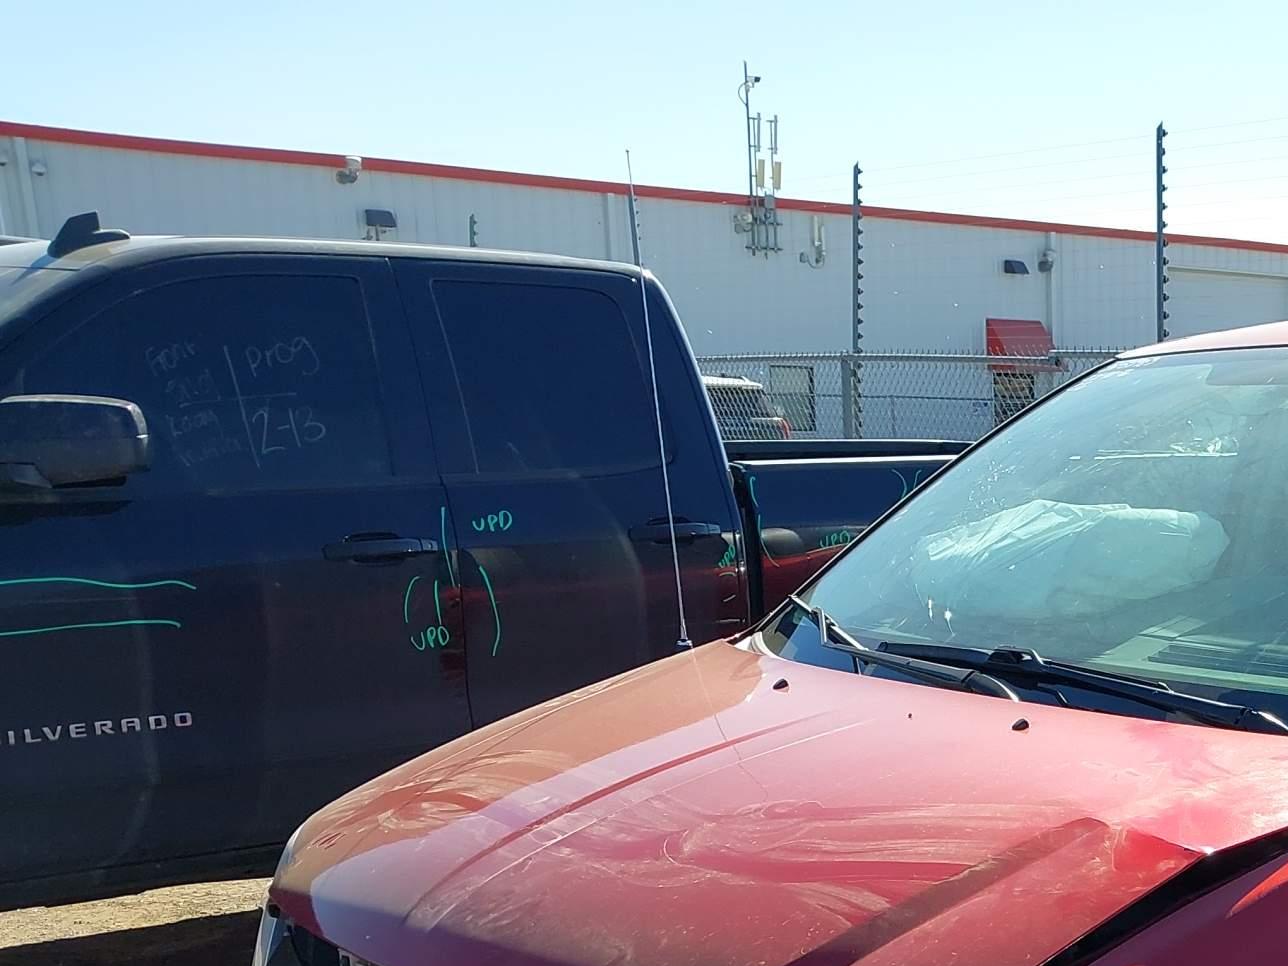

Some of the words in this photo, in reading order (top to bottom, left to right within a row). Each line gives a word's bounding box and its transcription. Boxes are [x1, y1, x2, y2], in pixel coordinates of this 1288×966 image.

[472, 510, 512, 532] UPD
[411, 626, 450, 651] UPD
[0, 711, 193, 746] ILVERADO
